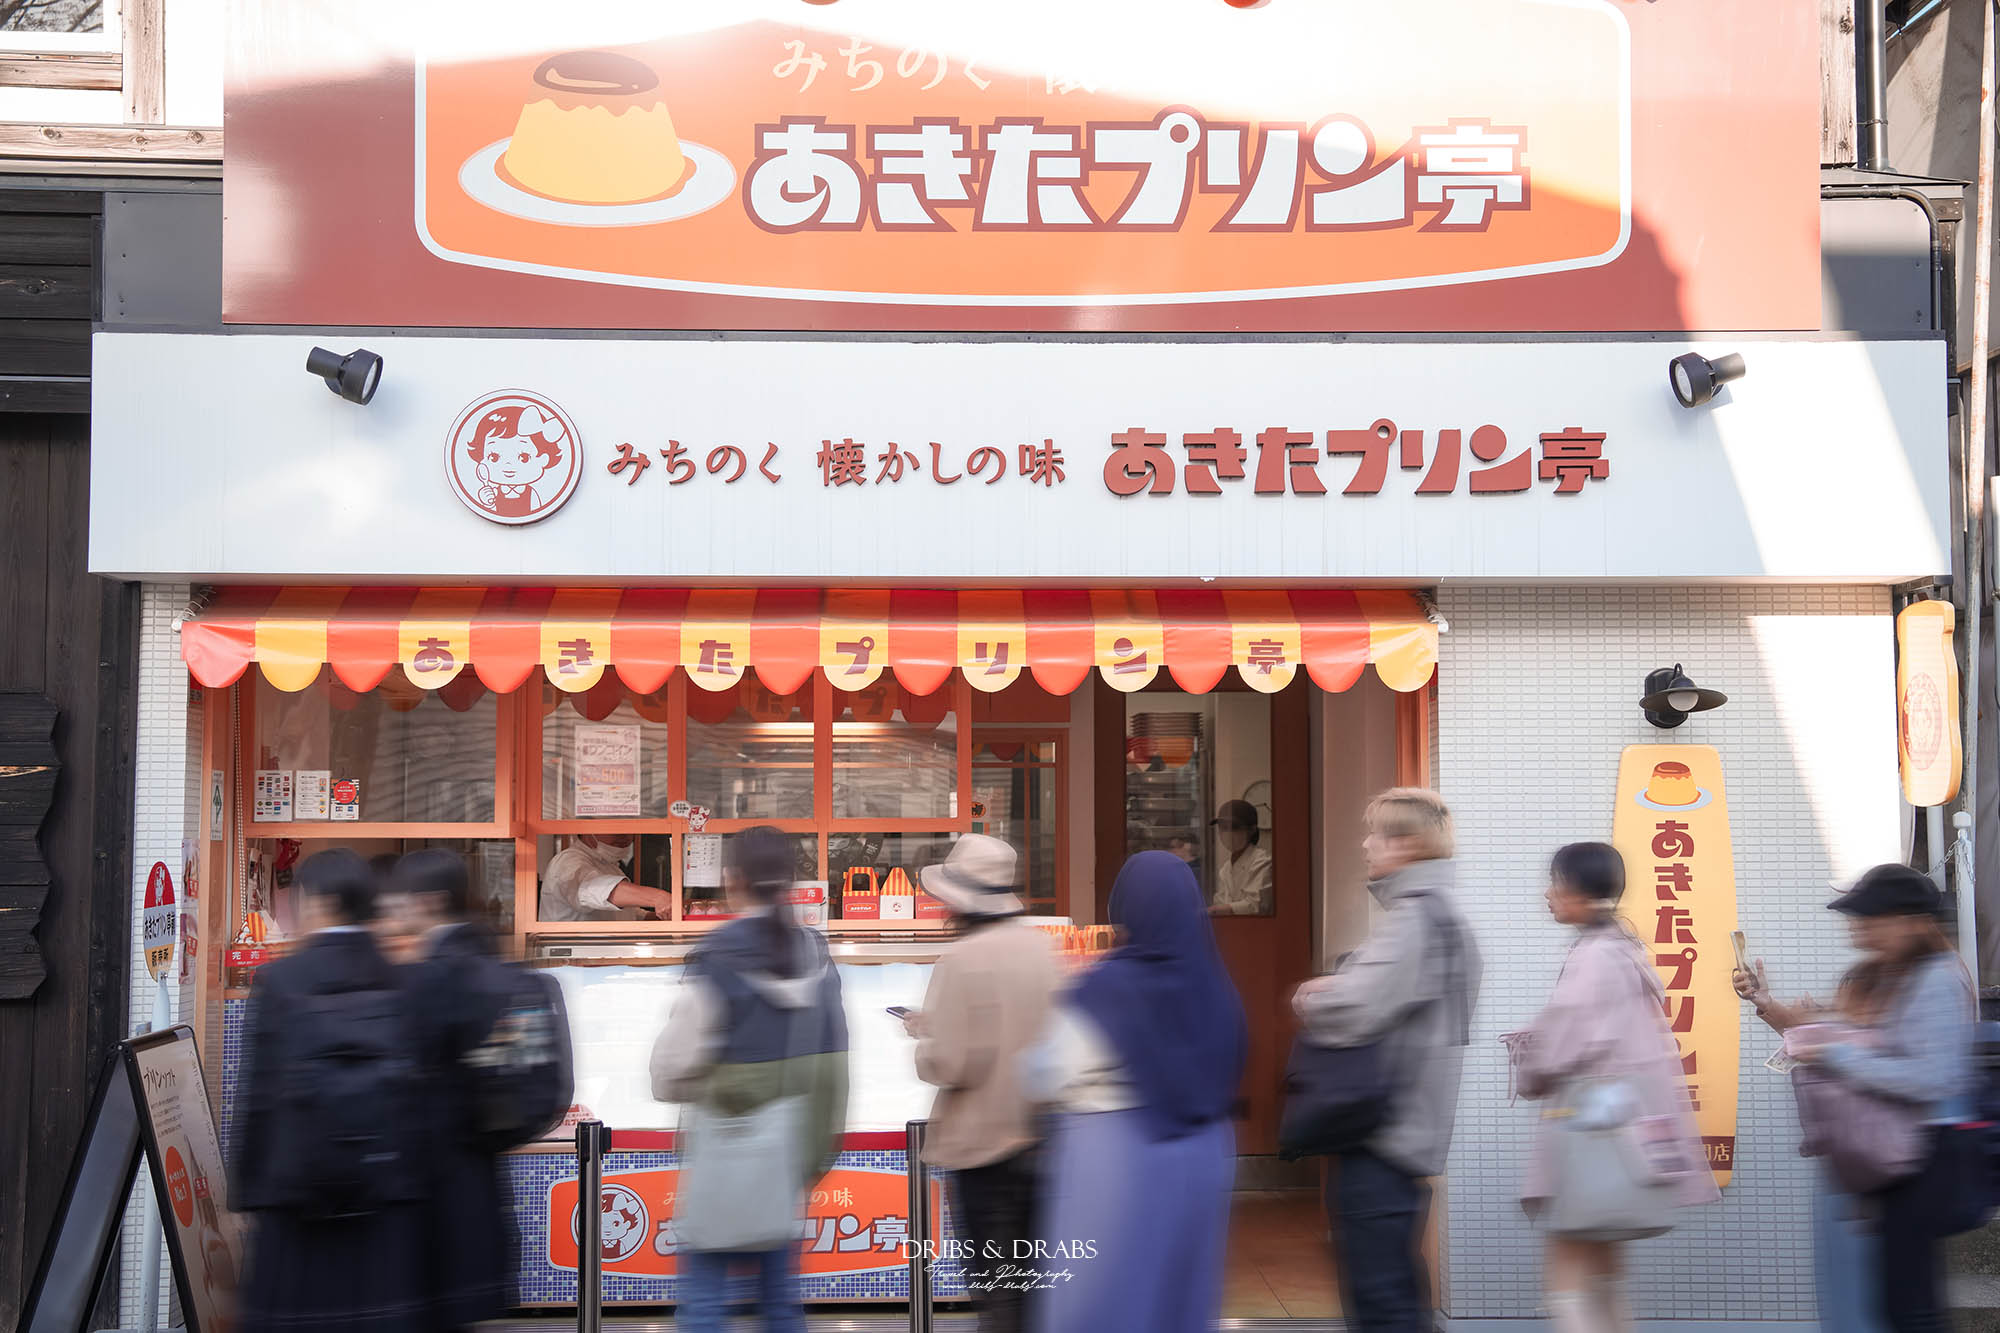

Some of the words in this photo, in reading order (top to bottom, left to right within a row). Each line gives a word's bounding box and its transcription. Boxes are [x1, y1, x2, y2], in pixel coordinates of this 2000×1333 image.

[743, 104, 1532, 233] あきたプリン亭
[607, 439, 782, 486] みちのく
[817, 437, 1067, 487] 懐かしの味
[1102, 418, 1611, 497] あきたプリン亭
